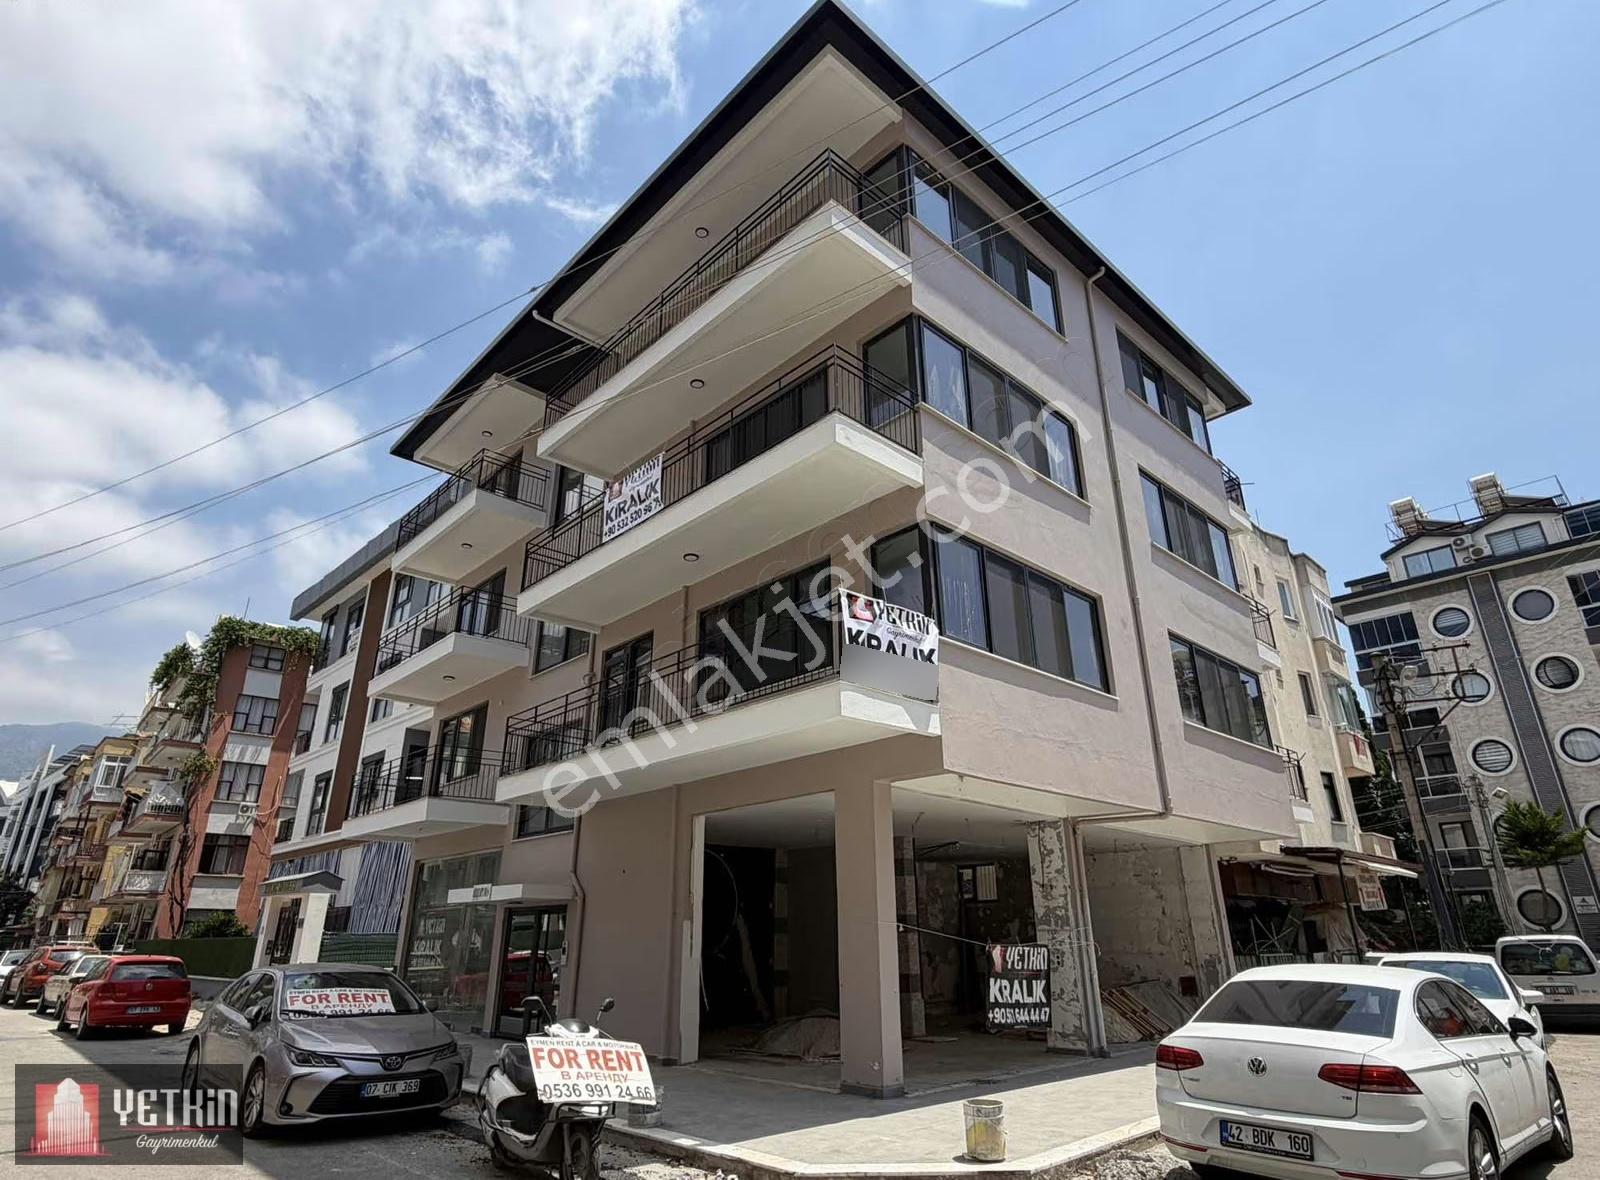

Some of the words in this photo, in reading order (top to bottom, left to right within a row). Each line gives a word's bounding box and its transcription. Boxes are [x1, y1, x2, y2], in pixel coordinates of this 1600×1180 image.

[606, 478, 660, 526] KIRALIK
[630, 507, 643, 523] 520
[289, 993, 332, 1006] FOR
[337, 992, 389, 1003] RENT
[532, 1047, 583, 1070] FOR
[585, 1049, 644, 1072] RENT
[543, 1083, 583, 1100] 0536
[585, 1083, 612, 1098] 991
[615, 1085, 633, 1099] 24
[636, 1086, 652, 1100] 66
[1228, 1125, 1243, 1142] 42
[1252, 1128, 1276, 1148] BDK
[1287, 1134, 1309, 1153] 160
